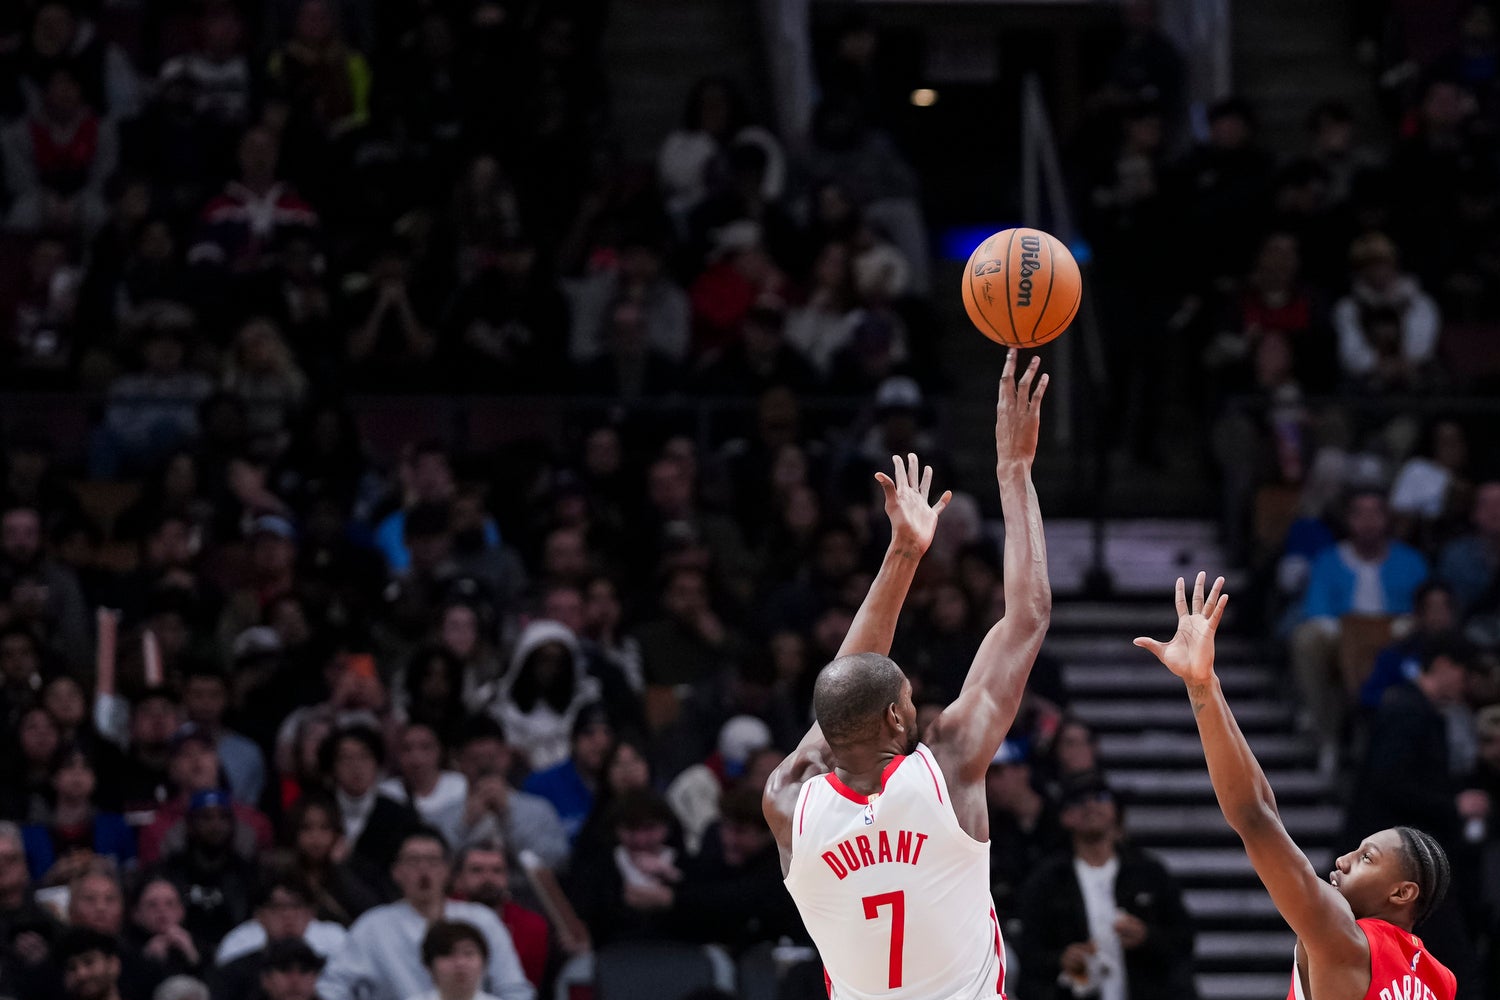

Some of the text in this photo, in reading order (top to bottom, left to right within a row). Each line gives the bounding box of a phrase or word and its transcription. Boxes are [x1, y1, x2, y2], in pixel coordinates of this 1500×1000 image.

[1016, 235, 1041, 307] Wilson
[821, 830, 929, 881] DURANT
[861, 889, 905, 990] 7
